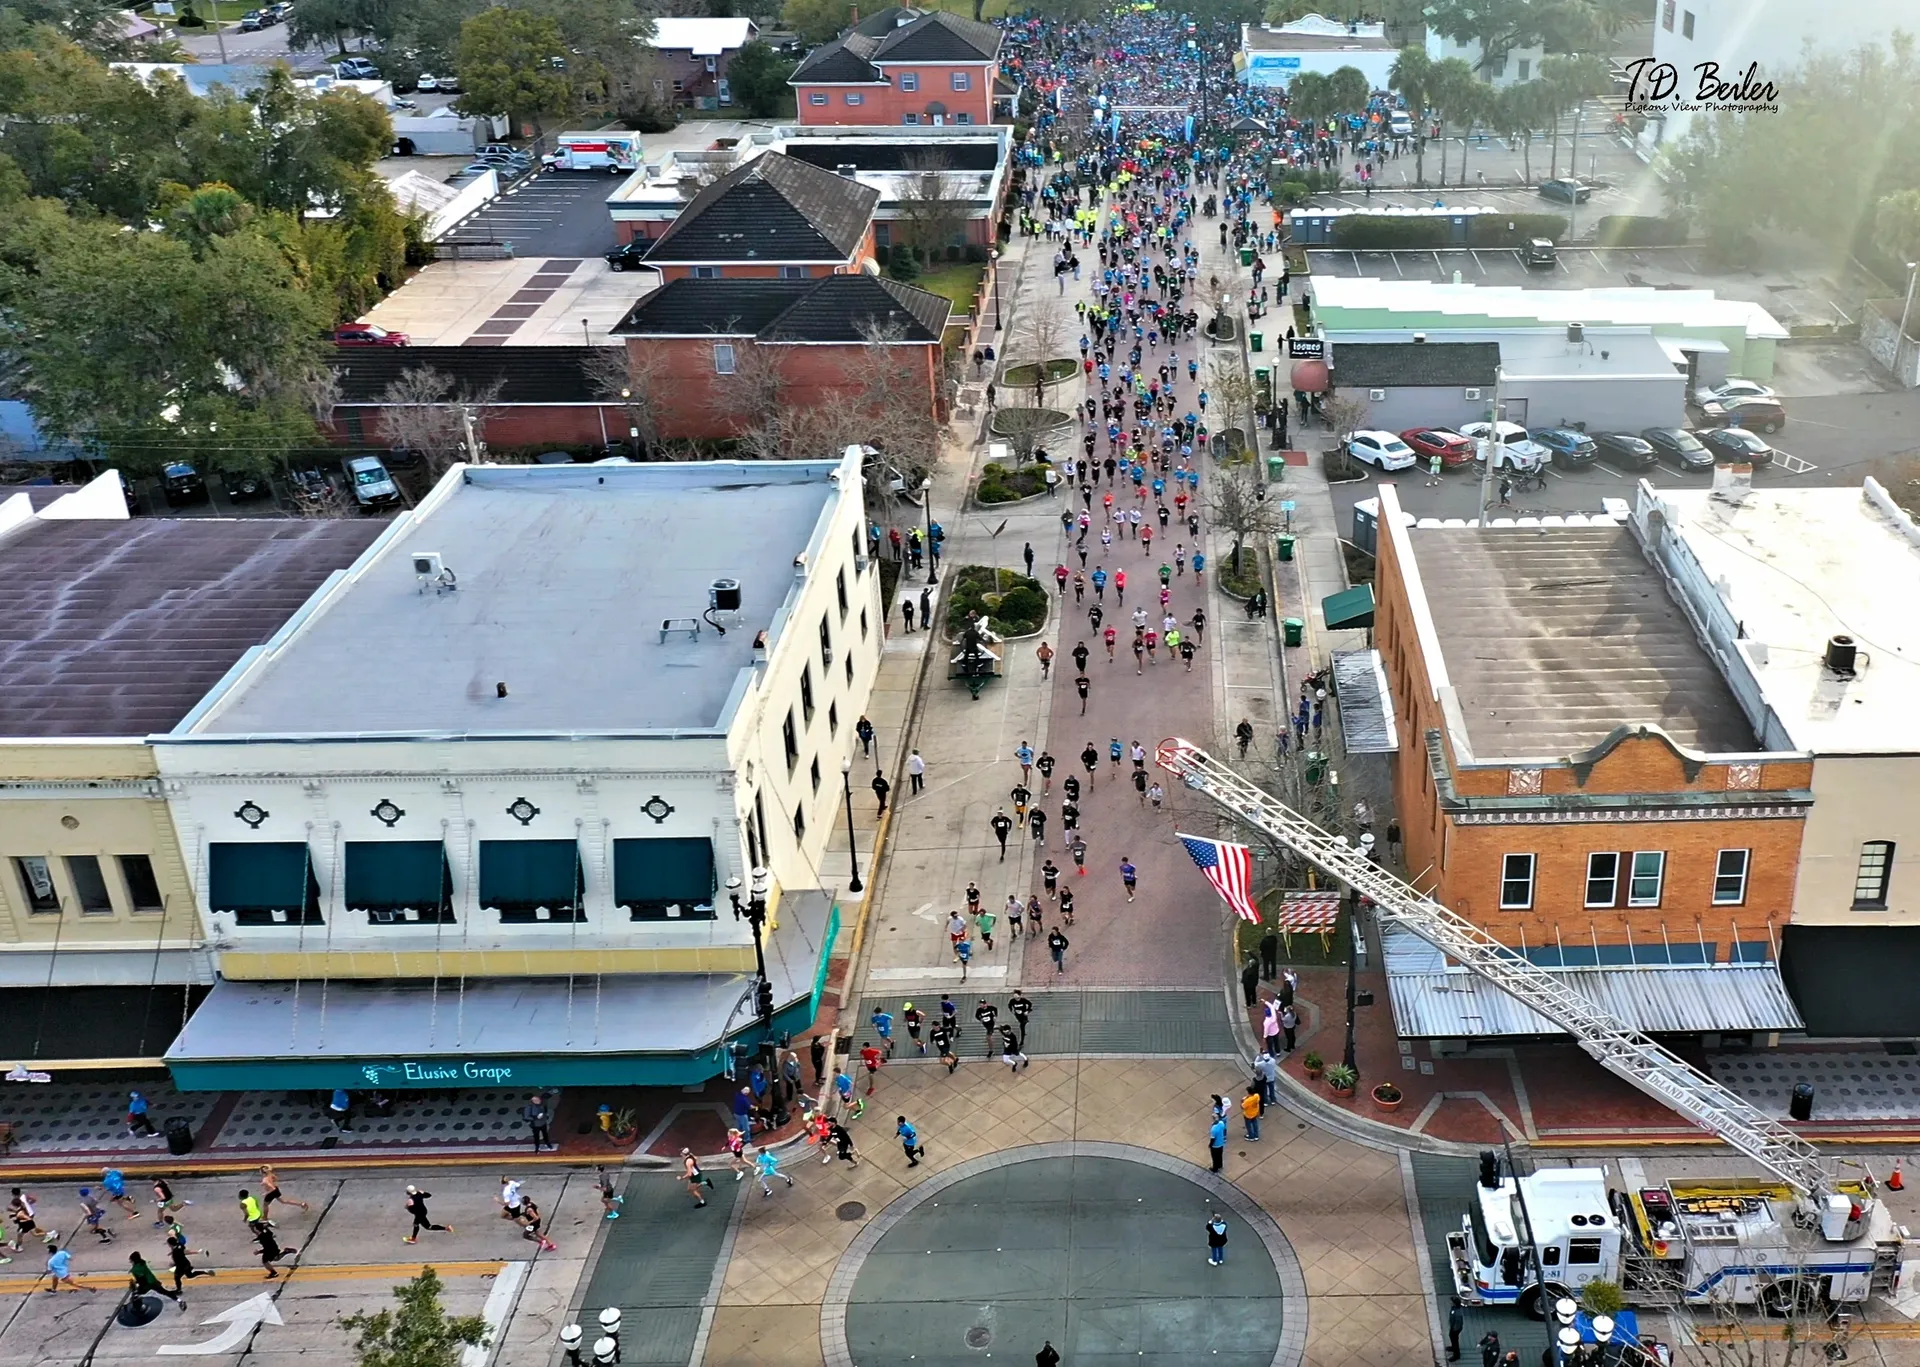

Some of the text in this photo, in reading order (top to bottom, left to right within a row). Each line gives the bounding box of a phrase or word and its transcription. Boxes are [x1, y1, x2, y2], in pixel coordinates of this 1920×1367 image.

[403, 1061, 512, 1083] Elusive Grape
[1683, 1091, 1705, 1114] FIRE
[1706, 1111, 1761, 1150] DEPARTMENT
